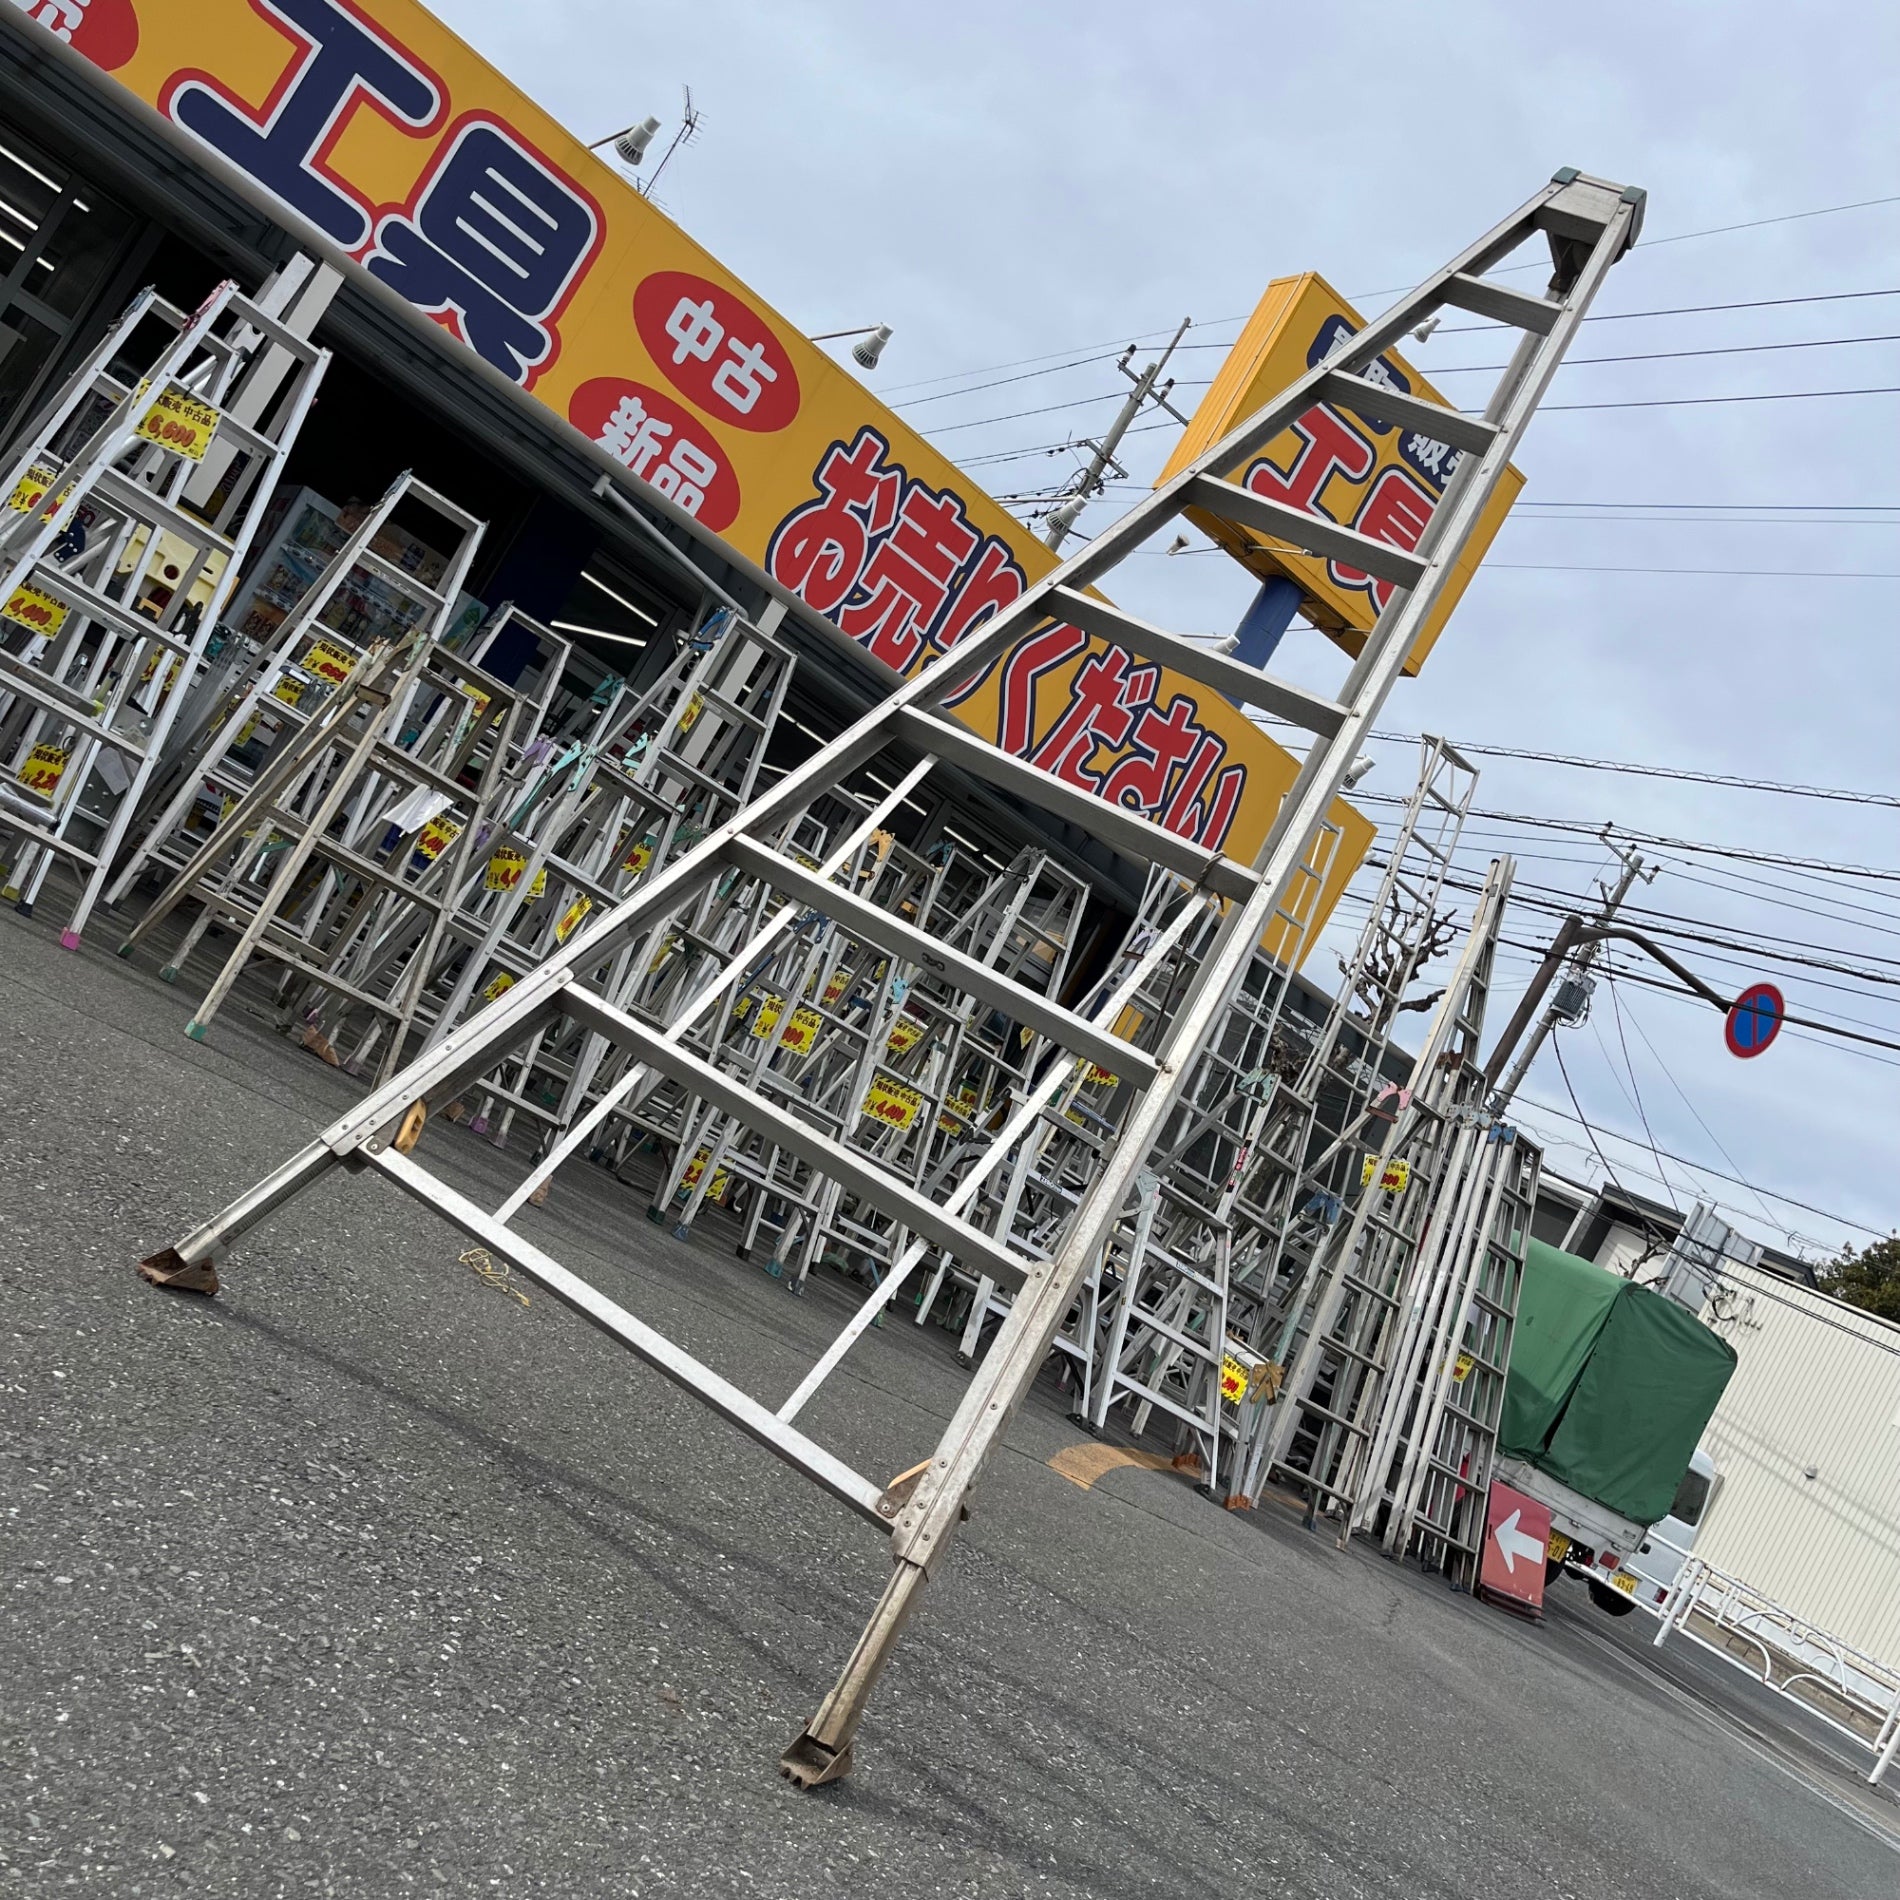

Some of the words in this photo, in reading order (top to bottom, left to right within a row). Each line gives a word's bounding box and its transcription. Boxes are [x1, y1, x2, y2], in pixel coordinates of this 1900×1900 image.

[157, 0, 606, 392] 工具
[663, 295, 779, 415] 中古
[183, 405, 213, 428] 中古品
[596, 395, 719, 518] 新品
